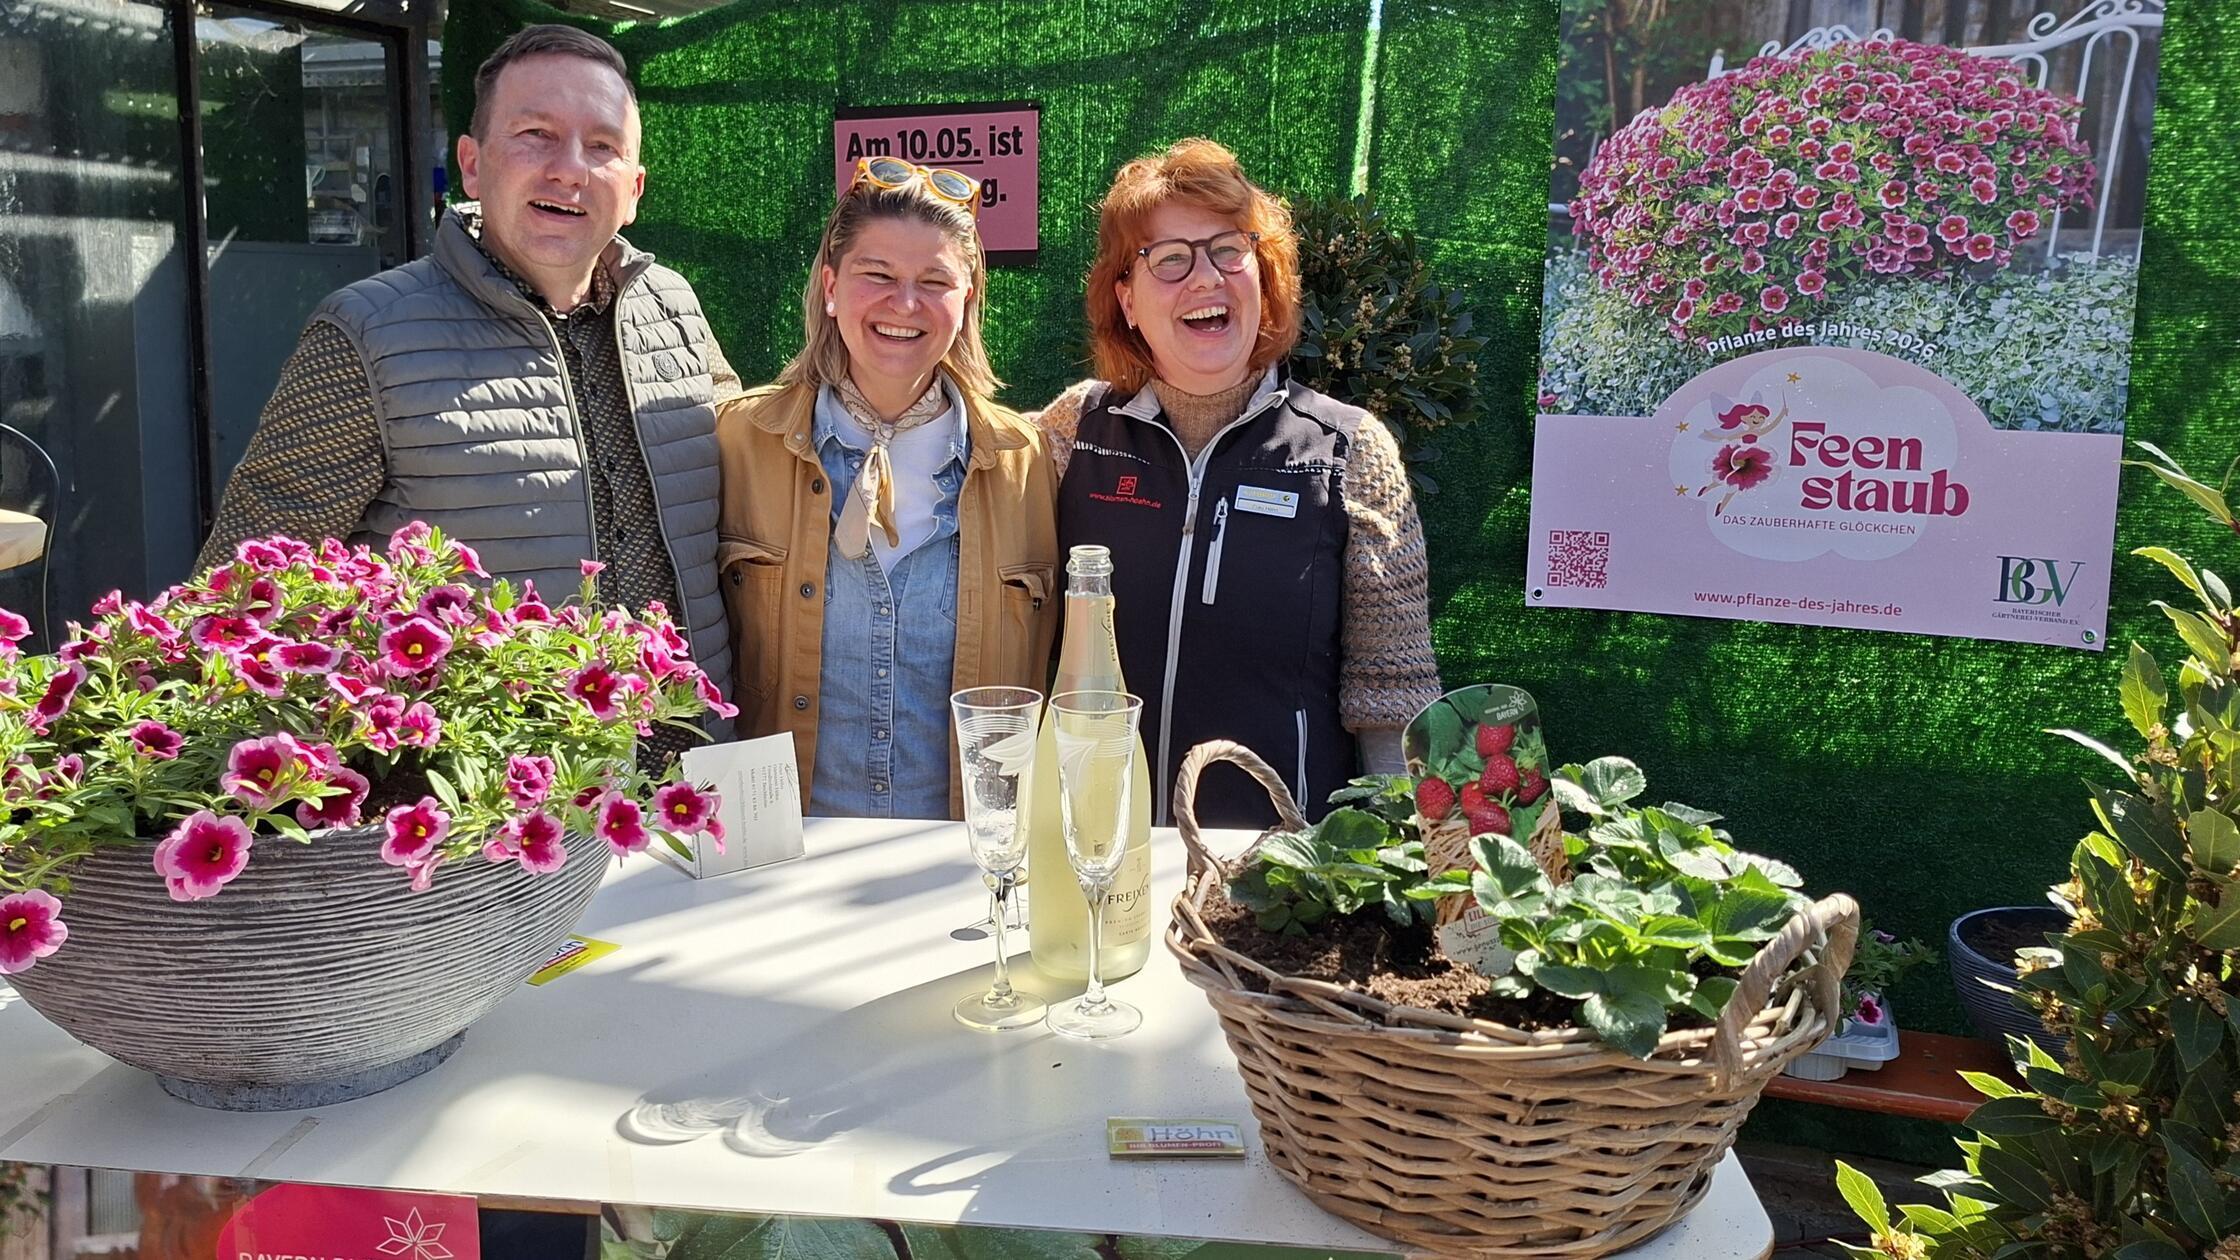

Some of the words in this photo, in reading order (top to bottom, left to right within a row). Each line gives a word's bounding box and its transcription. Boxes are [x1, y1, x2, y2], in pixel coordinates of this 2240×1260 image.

[846, 132, 891, 162] Am
[897, 127, 981, 160] 10.05.
[989, 125, 1023, 156] ist
[1706, 326, 1777, 356] Pflanze
[1781, 321, 1815, 337] des
[1820, 320, 1882, 342] Jahres
[1886, 330, 1938, 359] 2026
[1789, 421, 1923, 471] Feen
[1800, 469, 1970, 517] staub
[1723, 515, 1746, 526] DAS
[1750, 516, 1836, 531] ZAUBERHAFTE
[1839, 520, 1916, 535] GLÖCKCHEN
[1694, 591, 1903, 616] www.pflanze-des-jahres.de
[1107, 884, 1149, 905] FREIXE
[1151, 1126, 1235, 1141] Höhn
